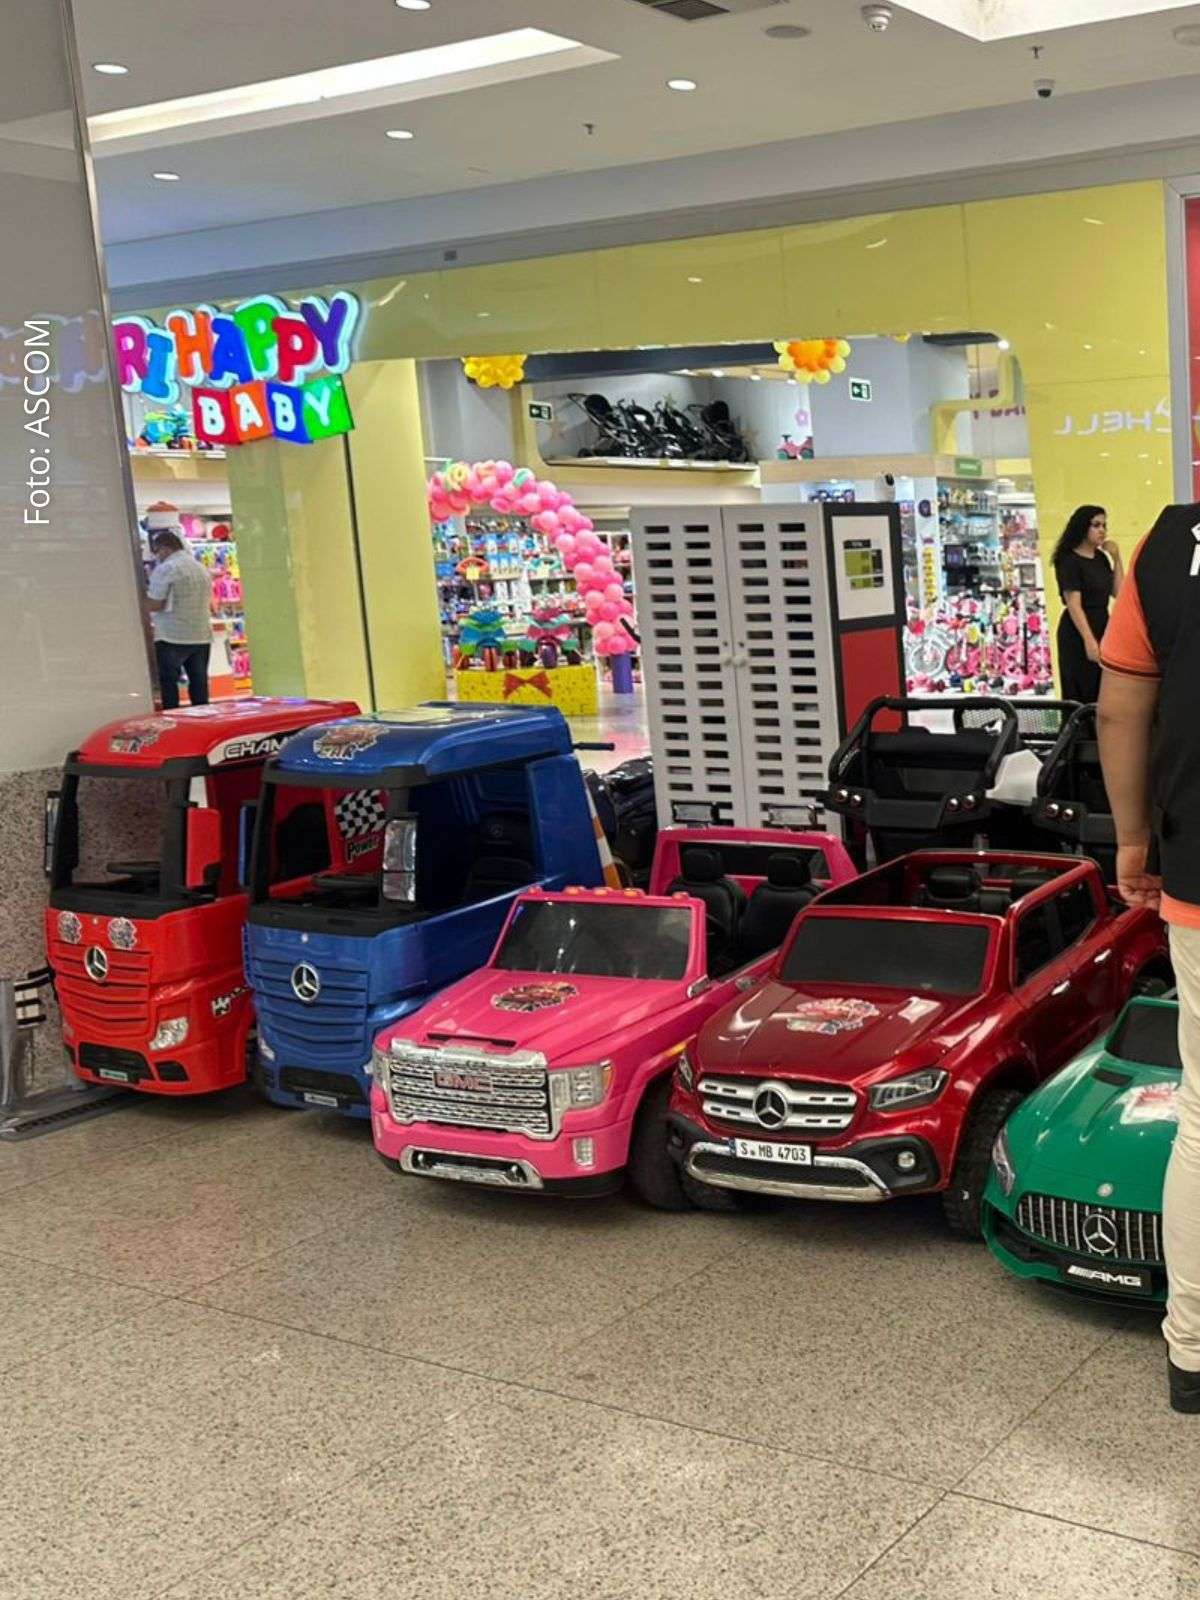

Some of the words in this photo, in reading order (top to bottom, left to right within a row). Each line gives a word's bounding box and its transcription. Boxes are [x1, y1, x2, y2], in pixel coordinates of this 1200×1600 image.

[165, 291, 357, 389] HAPPY
[196, 384, 333, 437] BABY
[777, 1145, 807, 1161] 4703
[1090, 1269, 1142, 1288] AMG
